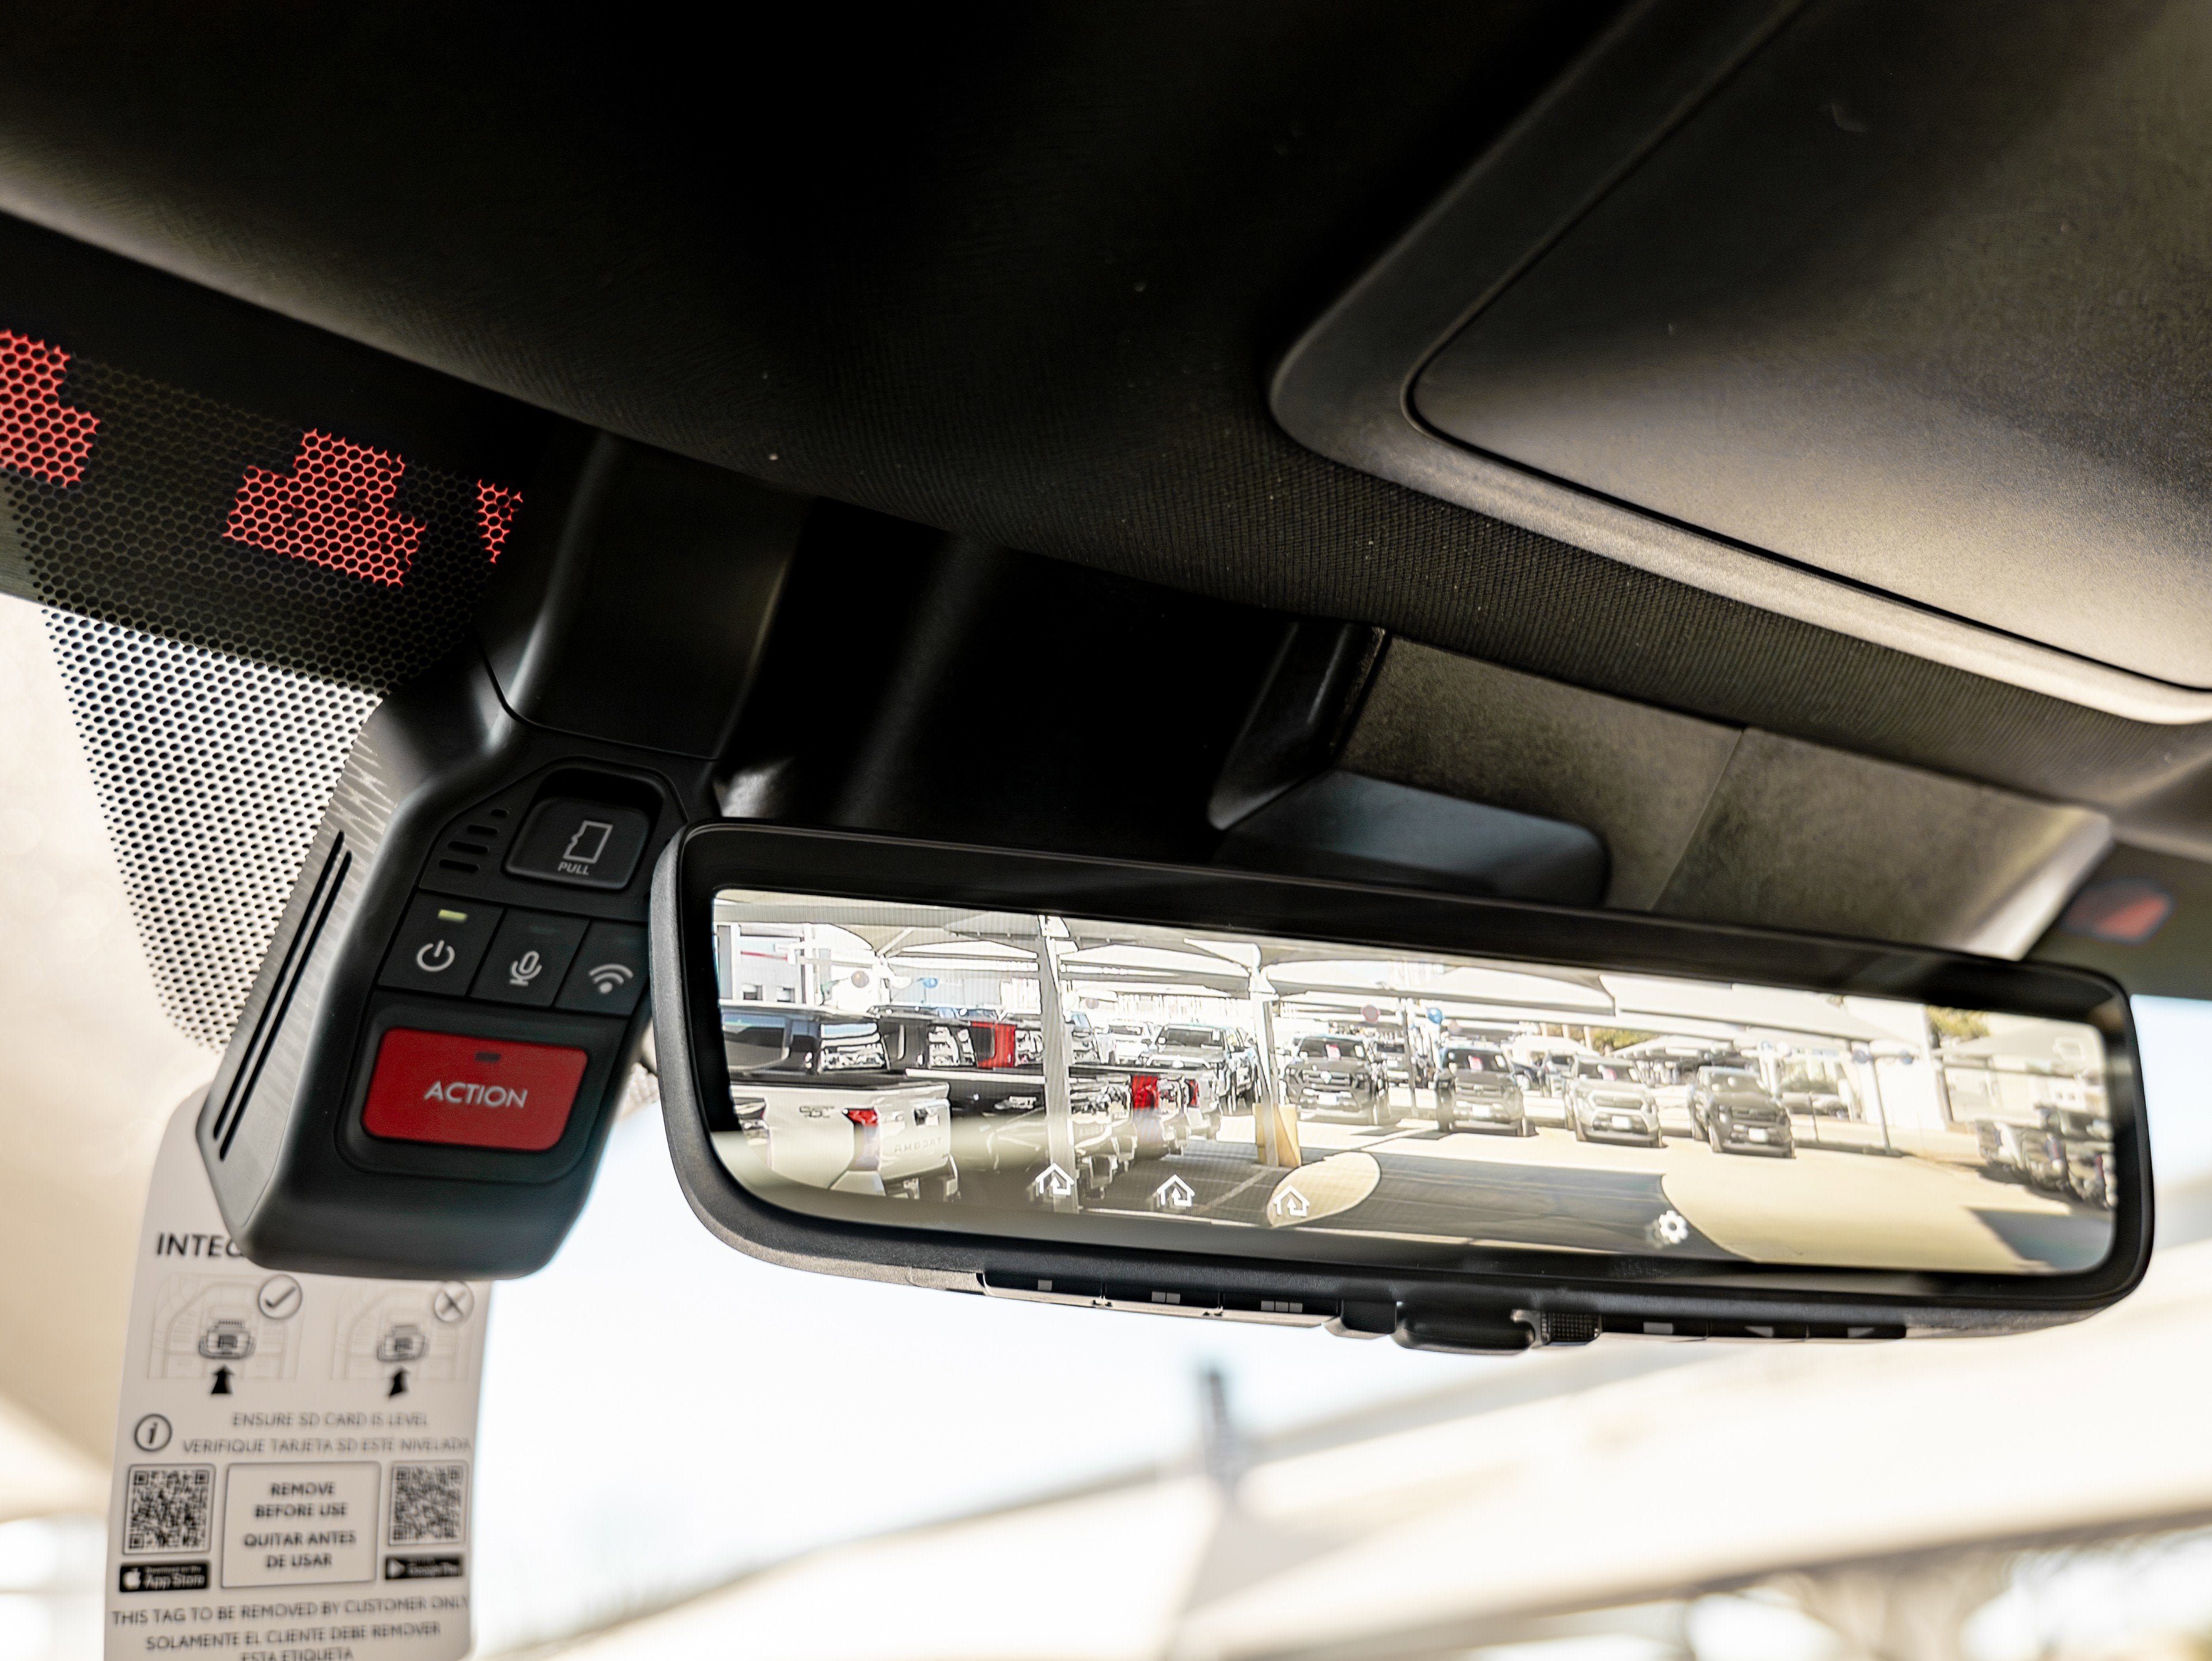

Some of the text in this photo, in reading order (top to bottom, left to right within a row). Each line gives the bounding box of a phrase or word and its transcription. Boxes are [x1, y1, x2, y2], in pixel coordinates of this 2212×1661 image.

[558, 861, 589, 875] PULL
[424, 1081, 528, 1108] ACTION
[232, 1412, 428, 1428] ENSURE SD CARD IS LEVEL
[183, 1439, 265, 1455] VERIFIQUE
[271, 1438, 334, 1454] TARJETA
[338, 1438, 358, 1452] SD
[400, 1437, 472, 1453] NIVELADA
[270, 1481, 336, 1496] REMOVE
[255, 1502, 348, 1518] BEFORE USE
[244, 1530, 357, 1547] QUITAR ANTES
[266, 1553, 332, 1568] DE USAR
[145, 1575, 171, 1590] App
[113, 1594, 469, 1625] THIS TAG TO BE REMOVED BY CUSTOMER ONLY
[146, 1621, 441, 1650] SOLAMENTE EL CLIENTE DEBE REMOVER
[281, 1646, 354, 1661] ETIQUETA
